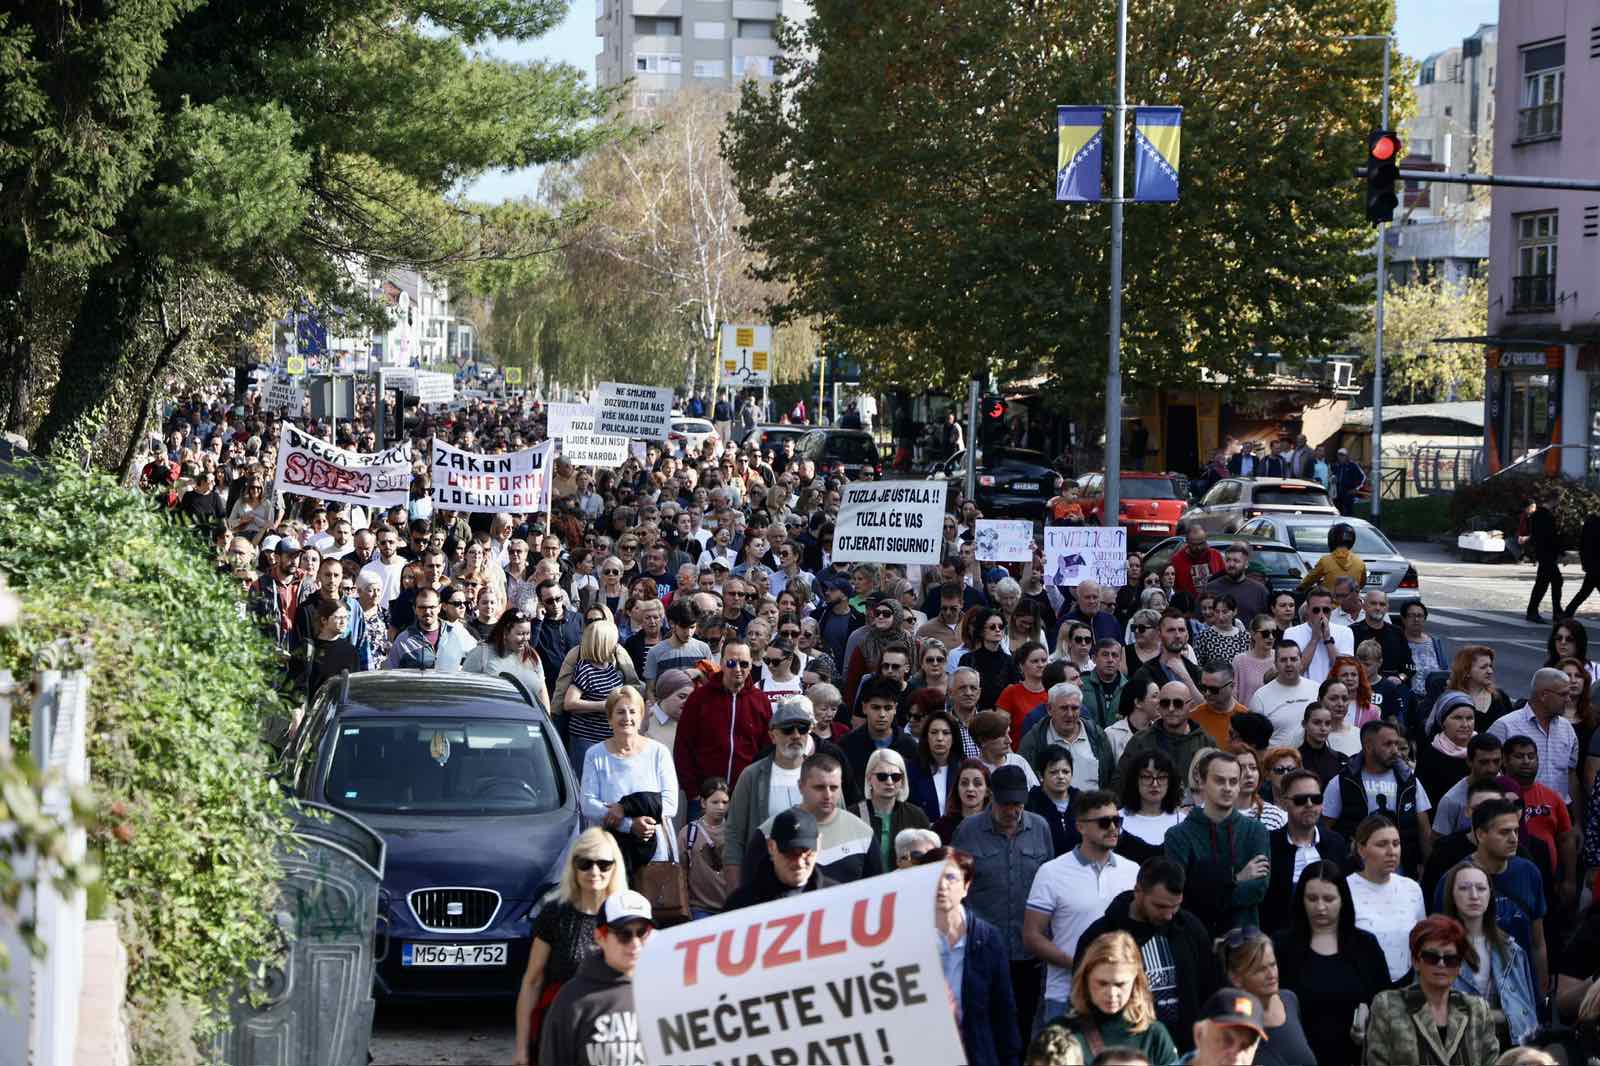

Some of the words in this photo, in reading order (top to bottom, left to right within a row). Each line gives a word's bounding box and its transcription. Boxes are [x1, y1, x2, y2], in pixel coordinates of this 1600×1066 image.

[616, 387, 624, 396] NE
[626, 388, 656, 398] SMIJEMO
[604, 399, 639, 409] DOZVOLITI
[640, 401, 649, 410] DA
[650, 402, 665, 412] NAS
[601, 410, 616, 420] VIŠE
[617, 413, 639, 422] IKADA
[640, 414, 665, 425] IJEDAN
[601, 422, 638, 434] POLICAJAC
[566, 435, 588, 446] LJUDE
[590, 436, 607, 446] KOJI
[608, 437, 626, 446] NISU
[435, 448, 512, 473] ZAKON
[532, 452, 542, 469] U
[568, 450, 586, 460] GLAS
[588, 451, 617, 461] NARODA
[847, 489, 877, 504] TUZLA
[878, 489, 892, 503] JE
[892, 488, 930, 504] USTALA
[932, 489, 940, 504] !!
[856, 511, 887, 527] TUZLA
[888, 508, 902, 528] ĆE
[903, 512, 924, 529] VAS
[838, 535, 885, 552] OTJERATI
[886, 537, 929, 553] SIGURNO
[930, 538, 935, 553] !
[674, 891, 898, 987] TUZLU
[415, 946, 504, 963] M56-A-752
[656, 984, 823, 1056] NEĆETE
[826, 961, 928, 1019] VIŠE
[592, 1011, 639, 1042] SAV
